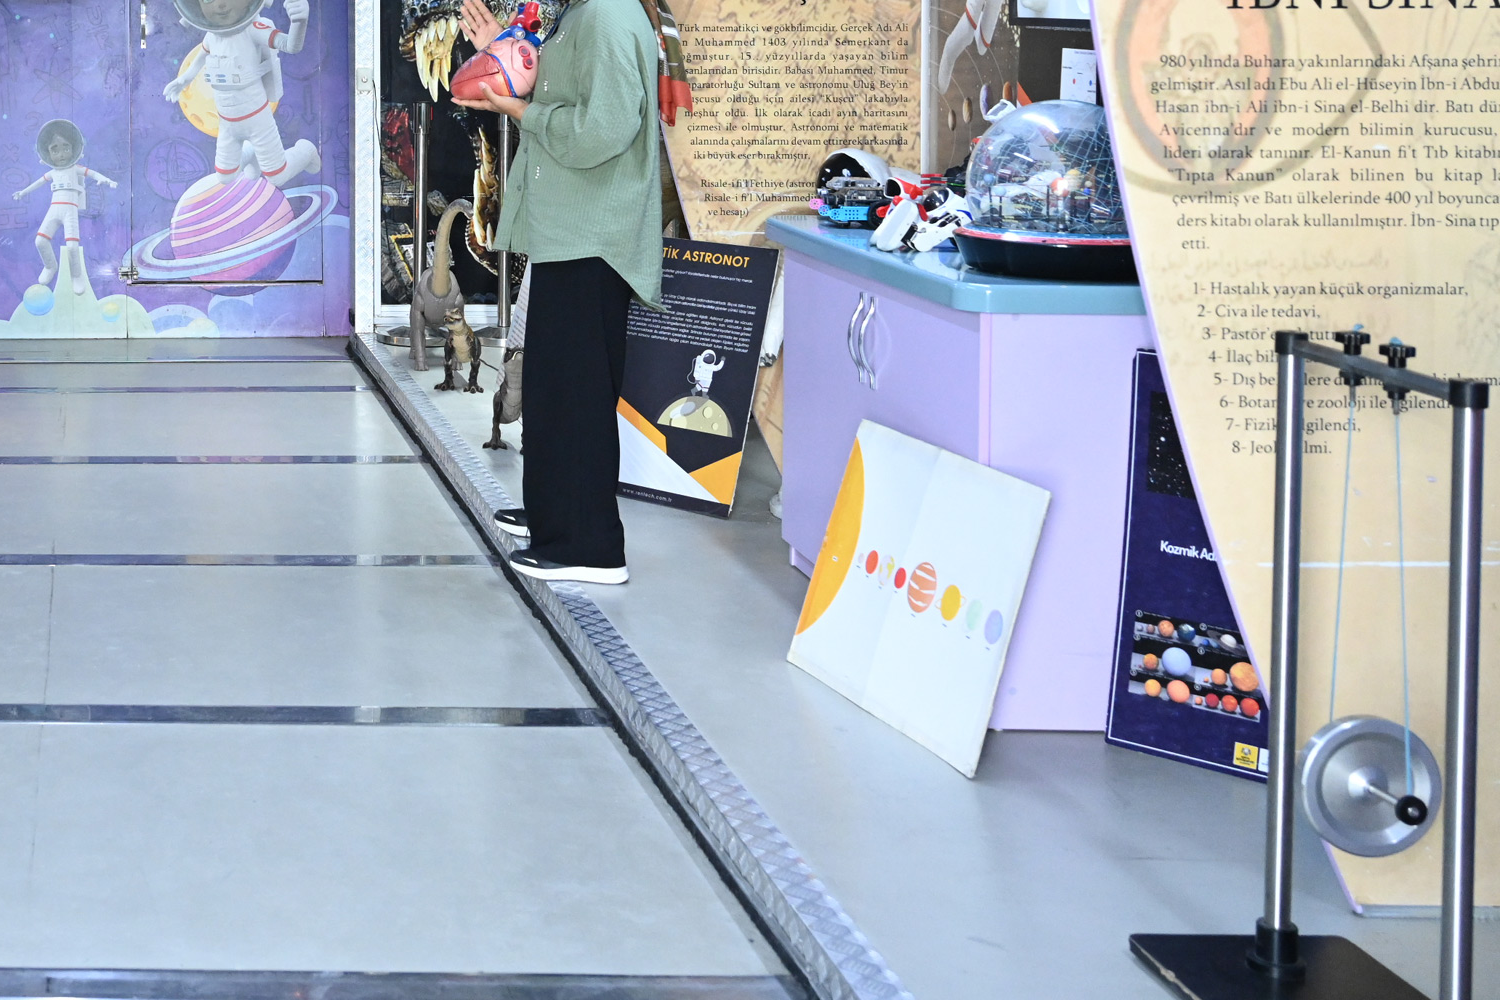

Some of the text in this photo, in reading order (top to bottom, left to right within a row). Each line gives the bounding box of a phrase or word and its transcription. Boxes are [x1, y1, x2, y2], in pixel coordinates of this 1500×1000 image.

[678, 23, 909, 34] Türk matematikçi ve gökbilimcidir. Gerçek Adı Ali
[695, 38, 756, 47] Muhammed
[762, 38, 786, 47] 1403
[792, 38, 829, 48] yılında
[835, 38, 891, 47] Semerkant
[897, 38, 909, 47] da
[765, 52, 909, 63] yüzyıllarda yaşayan bilim
[1160, 54, 1458, 72] 980 yılında Buhara yakınlarındaki Afşana
[742, 66, 781, 76] birisidir.
[785, 66, 814, 76] Babası
[879, 66, 909, 76] Timur
[785, 82, 795, 90] ve
[799, 81, 849, 90] astronomu
[853, 80, 876, 90] Uluğ
[1150, 77, 1219, 94] gelmiştir.
[1223, 77, 1251, 91] Asıl
[1254, 77, 1275, 91] adı
[1279, 77, 1307, 91] Ebu
[1311, 77, 1332, 91] Ali
[1336, 77, 1417, 94] el-Hüseyin
[1421, 74, 1457, 91] İbn-i
[727, 94, 760, 104] olduğu
[765, 94, 784, 105] için
[865, 94, 908, 105] lakabıyla
[725, 108, 749, 118] oldu.
[755, 107, 768, 118] İlk
[773, 108, 803, 118] olarak
[808, 108, 831, 118] icadı
[837, 110, 858, 119] ayın
[864, 108, 908, 118] haritasını
[1156, 100, 1473, 114] Hasan ibn-i Ali ibn-i Sina el-Belhi dir. Batı
[687, 122, 908, 134] çizmesi ile olmuştur. Astronomi ve matematik
[1265, 126, 1282, 136] ve
[1292, 122, 1349, 136] modern
[1360, 122, 1414, 136] bilimin
[1424, 122, 1498, 138] kurucusu,
[690, 137, 908, 148] alanında çalışmalarını devam ettirerek arkasında
[693, 151, 706, 160] iki
[707, 151, 736, 162] büyük
[757, 151, 810, 162] bırakmıştır.
[1163, 145, 1202, 160] lideri
[1207, 145, 1253, 160] olarak
[1260, 148, 1314, 160] tanınır.
[1321, 145, 1391, 160] El-Kanun
[1423, 145, 1449, 160] Tıb
[1292, 168, 1339, 182] olarak
[1350, 168, 1404, 182] bilinen
[1415, 168, 1433, 182] bu
[1444, 168, 1483, 185] kitap
[750, 179, 784, 190] Fethiye
[704, 193, 738, 202] Risale-i
[1172, 190, 1500, 208] çevrilmiş ve Batı ülkelerinde 400 yıl boyunca
[720, 207, 749, 218] hesap)
[1177, 213, 1207, 228] ders
[1210, 213, 1252, 228] kitabı
[1255, 213, 1300, 228] olarak
[1303, 213, 1407, 230] kullanılmıştır.
[1445, 213, 1476, 228] Sina
[1182, 236, 1210, 250] etti.
[682, 250, 750, 268] ASTRONOT
[1193, 282, 1468, 299] 1- Hastalık yayan küçük organizmalar,
[1197, 304, 1320, 320] 2- Civa ile tedavi,
[1202, 326, 1217, 341] 3-
[1208, 346, 1252, 366] 4- İlaç
[1213, 372, 1255, 389] 5- Dış
[1219, 394, 1234, 408] 6-
[1226, 417, 1241, 432] 7-
[1232, 440, 1246, 454] 8-
[1160, 539, 1199, 558] Kozmik
